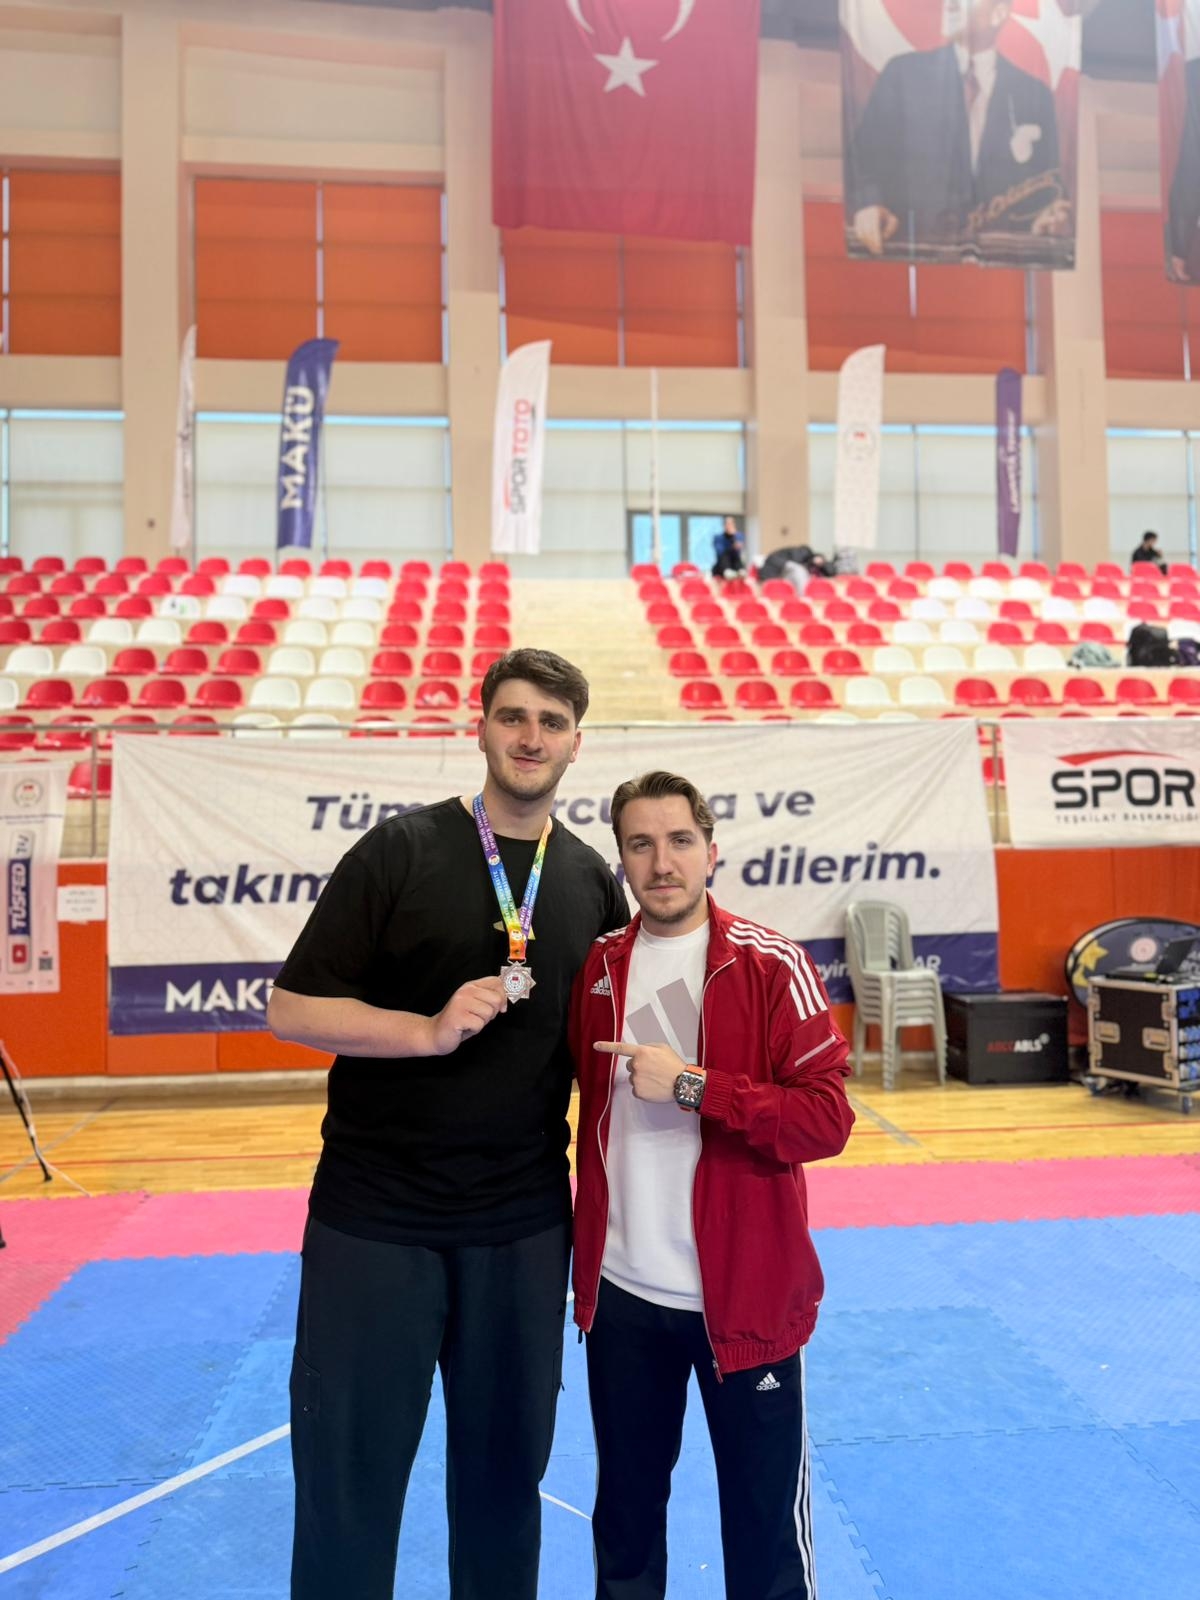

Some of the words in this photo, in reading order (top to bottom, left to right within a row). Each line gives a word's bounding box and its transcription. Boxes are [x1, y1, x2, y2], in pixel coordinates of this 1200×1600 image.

[281, 385, 315, 510] MAKÜ
[512, 398, 533, 455] TOTO
[755, 790, 815, 818] ve
[1051, 768, 1196, 809] SPOR
[10, 862, 27, 930] TÜSFED
[169, 864, 334, 906] takım
[741, 842, 941, 887] dilerim.
[756, 1381, 781, 1391] adidas
